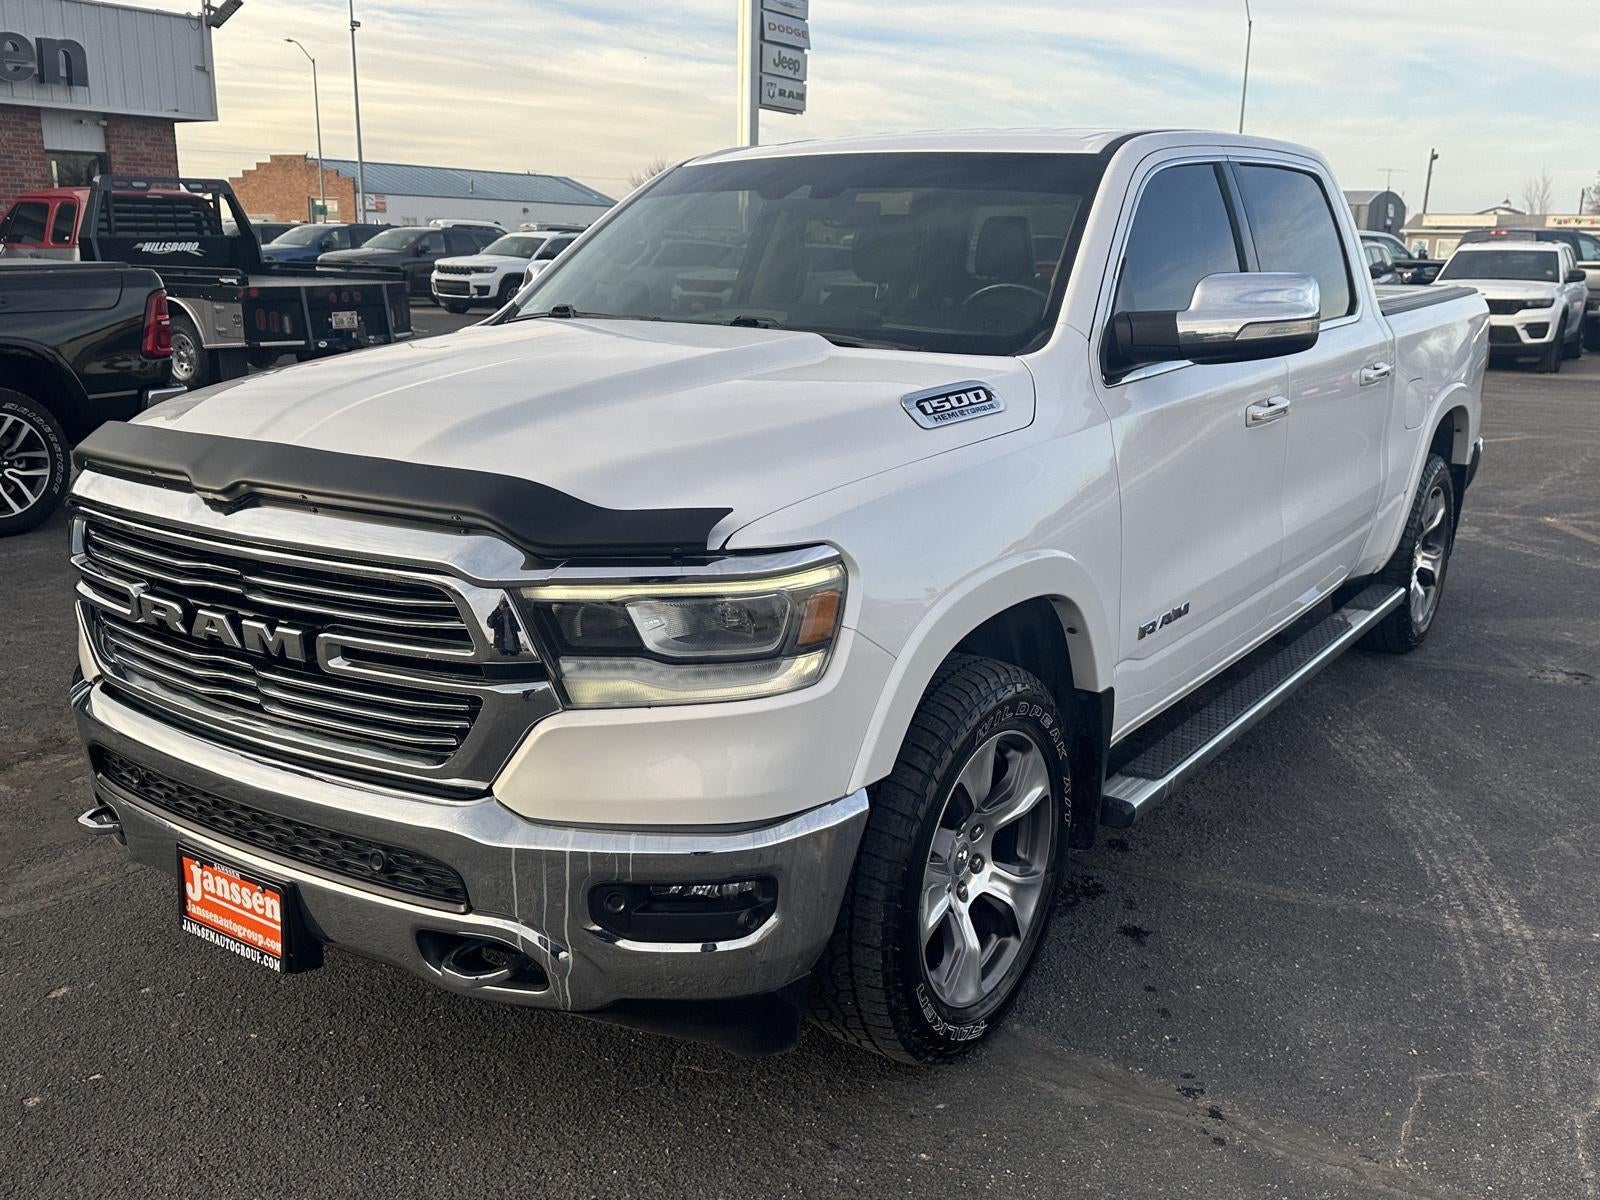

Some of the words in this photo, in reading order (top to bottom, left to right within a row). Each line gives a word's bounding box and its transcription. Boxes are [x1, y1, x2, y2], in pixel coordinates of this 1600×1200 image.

[768, 22, 808, 39] DODGE
[772, 50, 801, 75] Jeep
[778, 88, 805, 101] RAM
[142, 241, 200, 252] HILLSBORO
[919, 389, 988, 414] 1500
[933, 411, 959, 422] HEMI
[141, 593, 307, 662] RAM
[1138, 600, 1190, 641] RAM
[975, 701, 1068, 760] WILDPEAK
[182, 919, 281, 973] JANSSENAUTOGROUP.COM
[916, 983, 988, 1041] FALKEN
